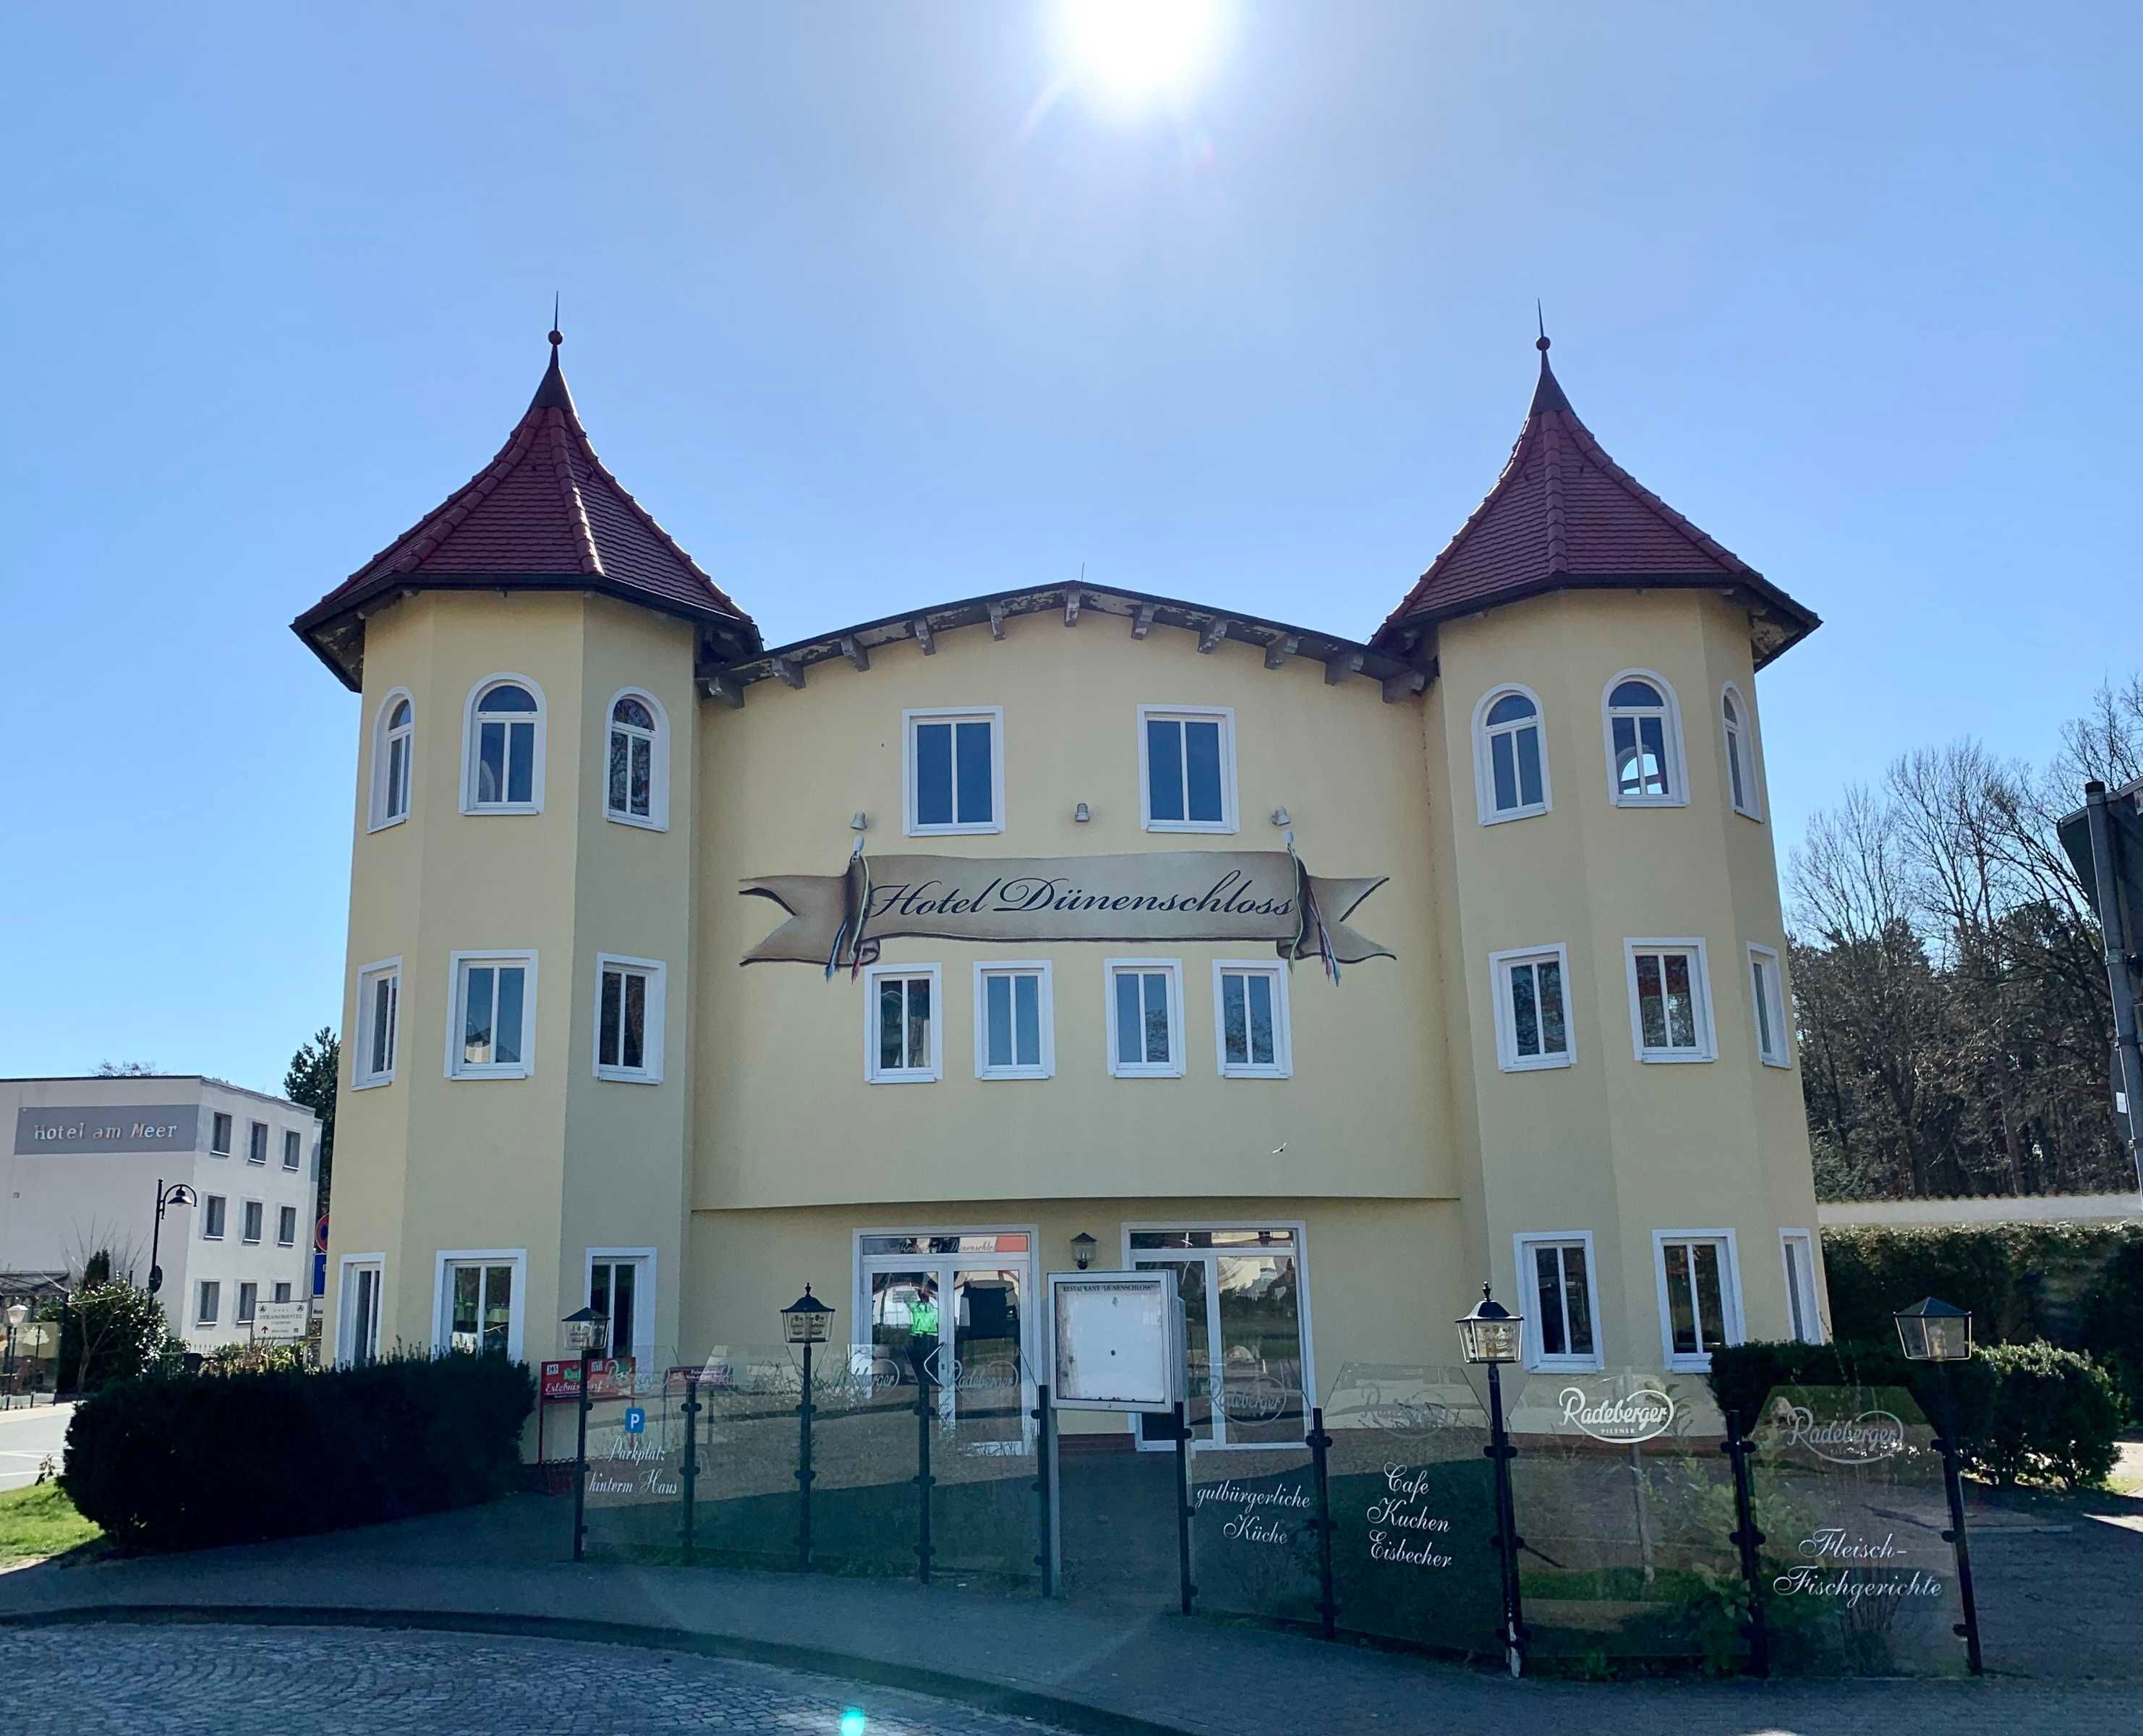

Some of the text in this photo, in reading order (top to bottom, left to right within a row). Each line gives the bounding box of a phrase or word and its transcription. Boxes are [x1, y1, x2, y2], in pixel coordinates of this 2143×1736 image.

[868, 869, 1295, 917] Hotel Dünenschloss
[34, 1123, 177, 1140] Hotel am Meer
[1559, 1387, 1669, 1434] Radeberger
[1787, 1407, 1900, 1451] Radeberger
[608, 1435, 665, 1466] Parkplatz
[589, 1468, 678, 1494] hinterm Haus
[1197, 1480, 1311, 1514] gutbürgerliche
[1384, 1462, 1430, 1503] Cafe
[1224, 1515, 1288, 1544] Küche
[1367, 1497, 1450, 1533] Kuchen
[1369, 1530, 1453, 1567] Eisbecher
[1799, 1528, 1907, 1558] Fleisch-
[1773, 1565, 1943, 1608] Fischgerichte
